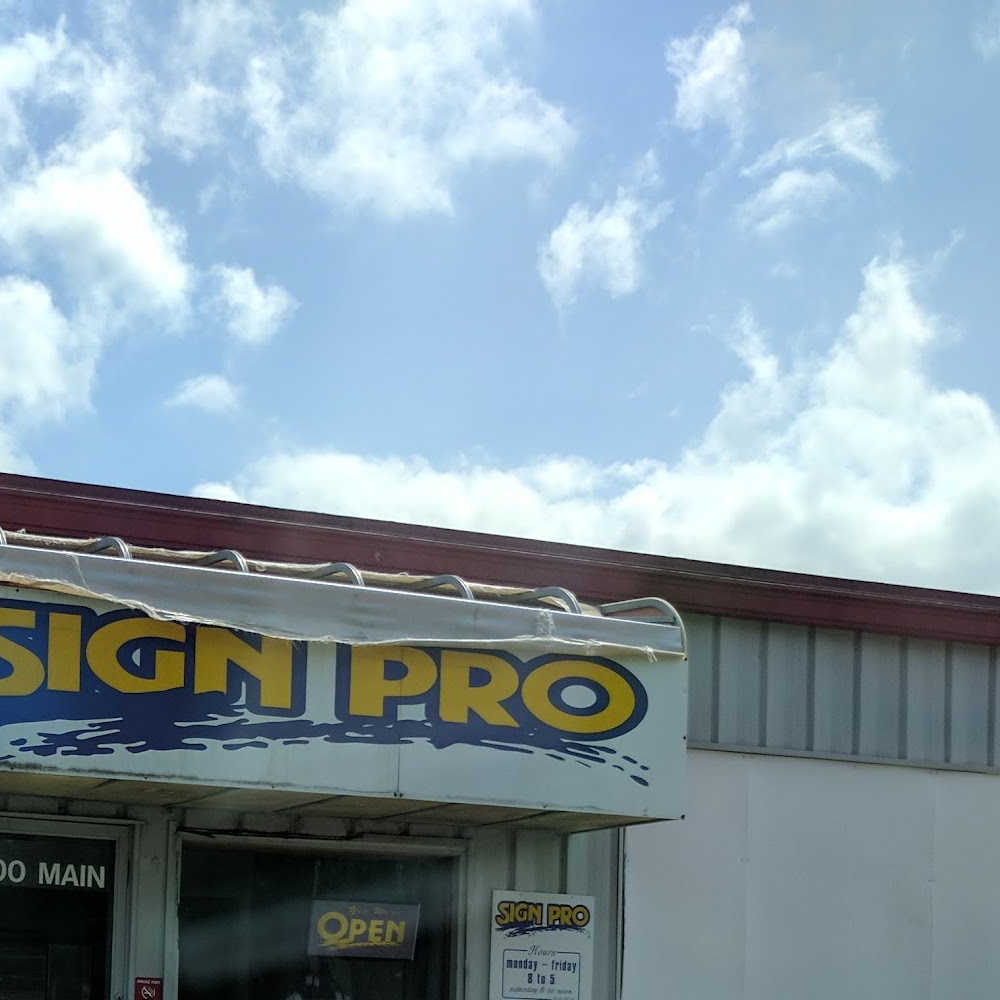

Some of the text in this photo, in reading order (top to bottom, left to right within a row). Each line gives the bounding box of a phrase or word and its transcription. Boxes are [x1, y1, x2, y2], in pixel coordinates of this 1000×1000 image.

[334, 643, 648, 741] PRO
[38, 861, 106, 889] MAIN
[316, 911, 407, 944] OPEN
[495, 900, 591, 929] SIGN PRO
[528, 945, 557, 957] Hours
[506, 959, 538, 972] monday
[551, 960, 577, 973] friday
[527, 973, 555, 985] 8 to 5
